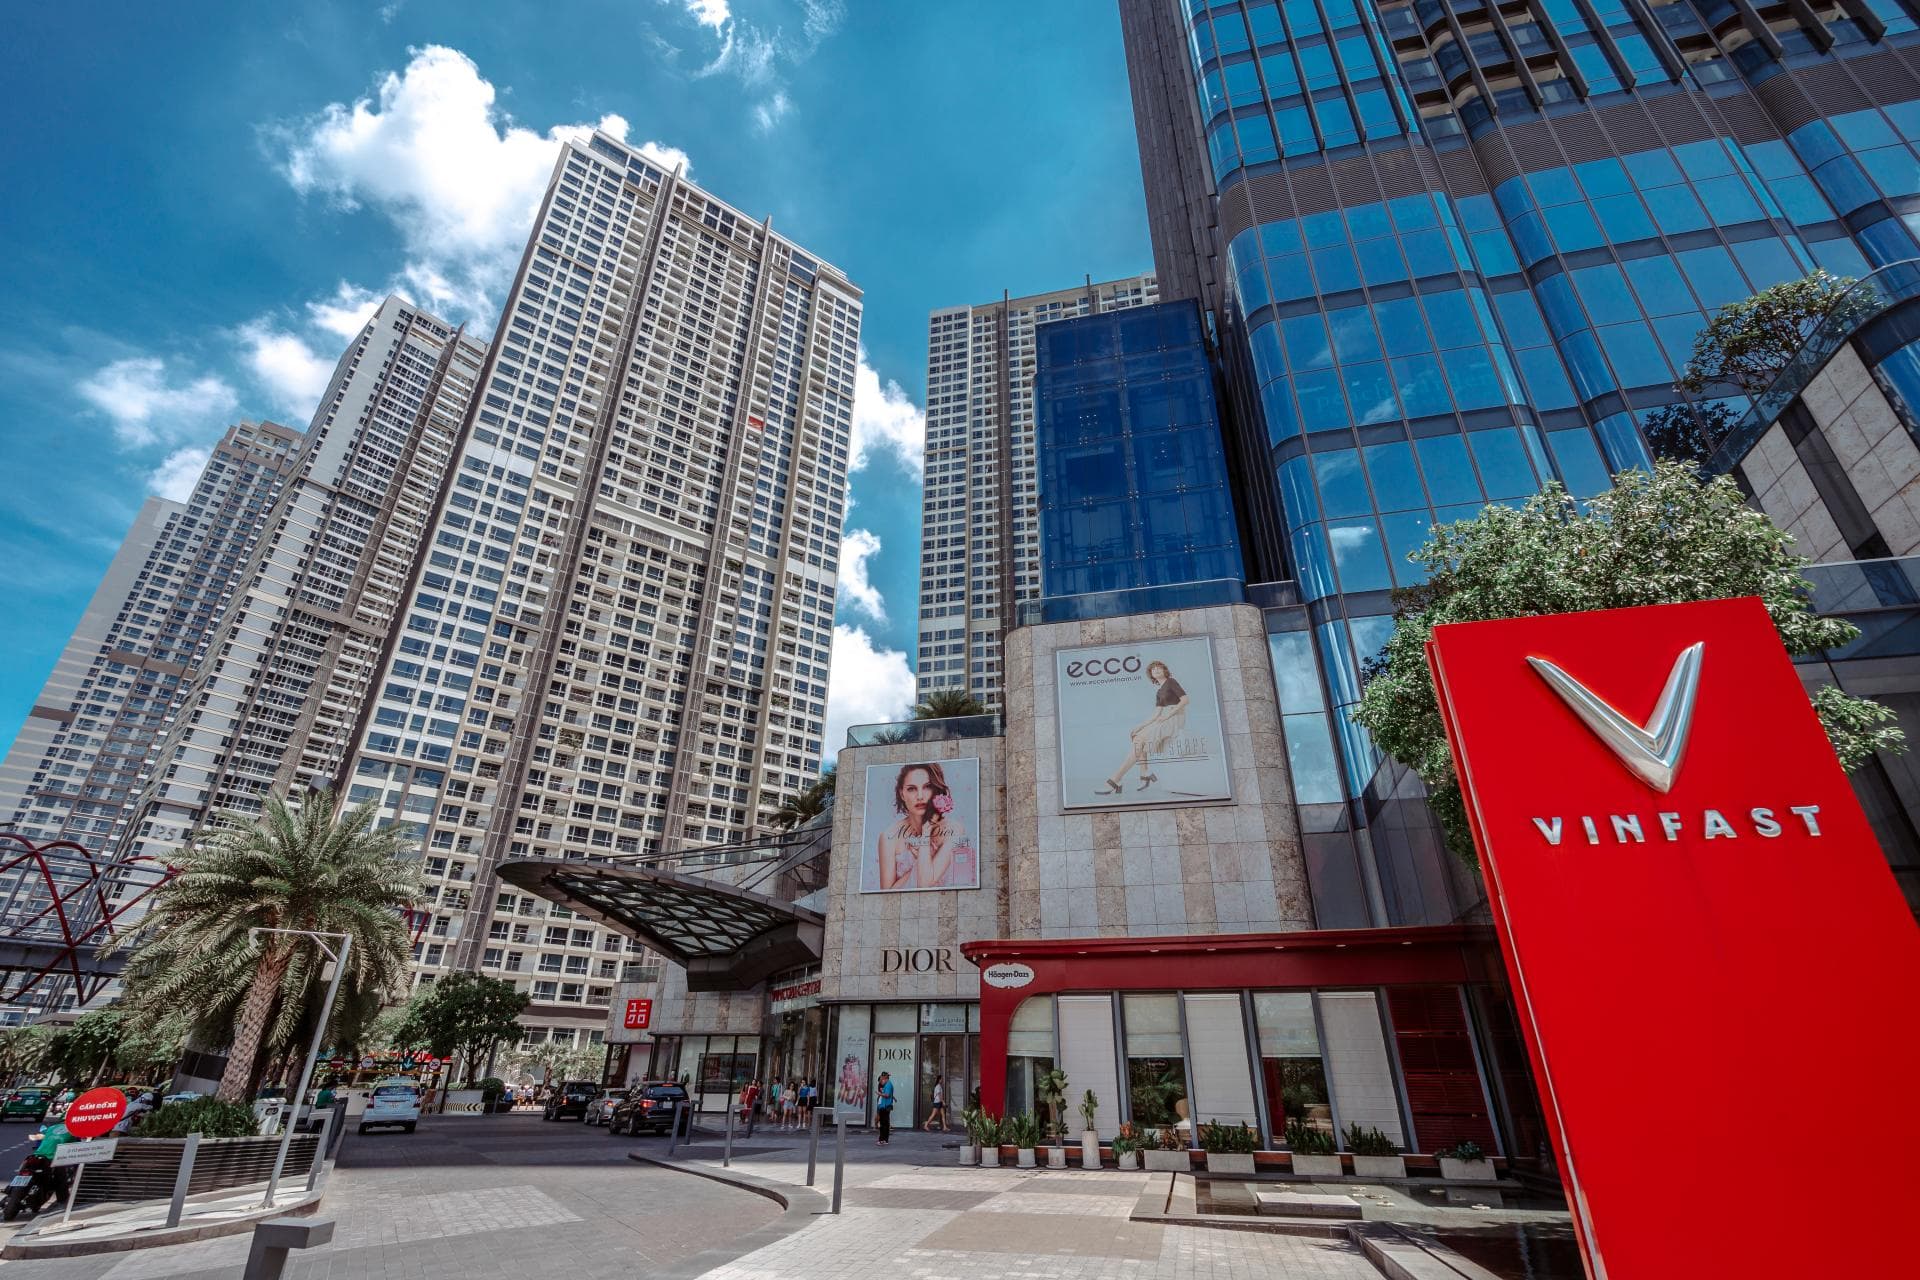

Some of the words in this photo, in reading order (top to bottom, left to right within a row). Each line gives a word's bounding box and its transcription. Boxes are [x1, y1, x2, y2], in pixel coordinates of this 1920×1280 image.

[1066, 655, 1142, 678] ecco
[1069, 675, 1142, 687] www.eccovietnam.vn
[1532, 804, 1821, 845] VINFAST
[881, 948, 955, 972] DIOR
[878, 1048, 912, 1060] DIOR
[72, 1115, 88, 1123] KHU
